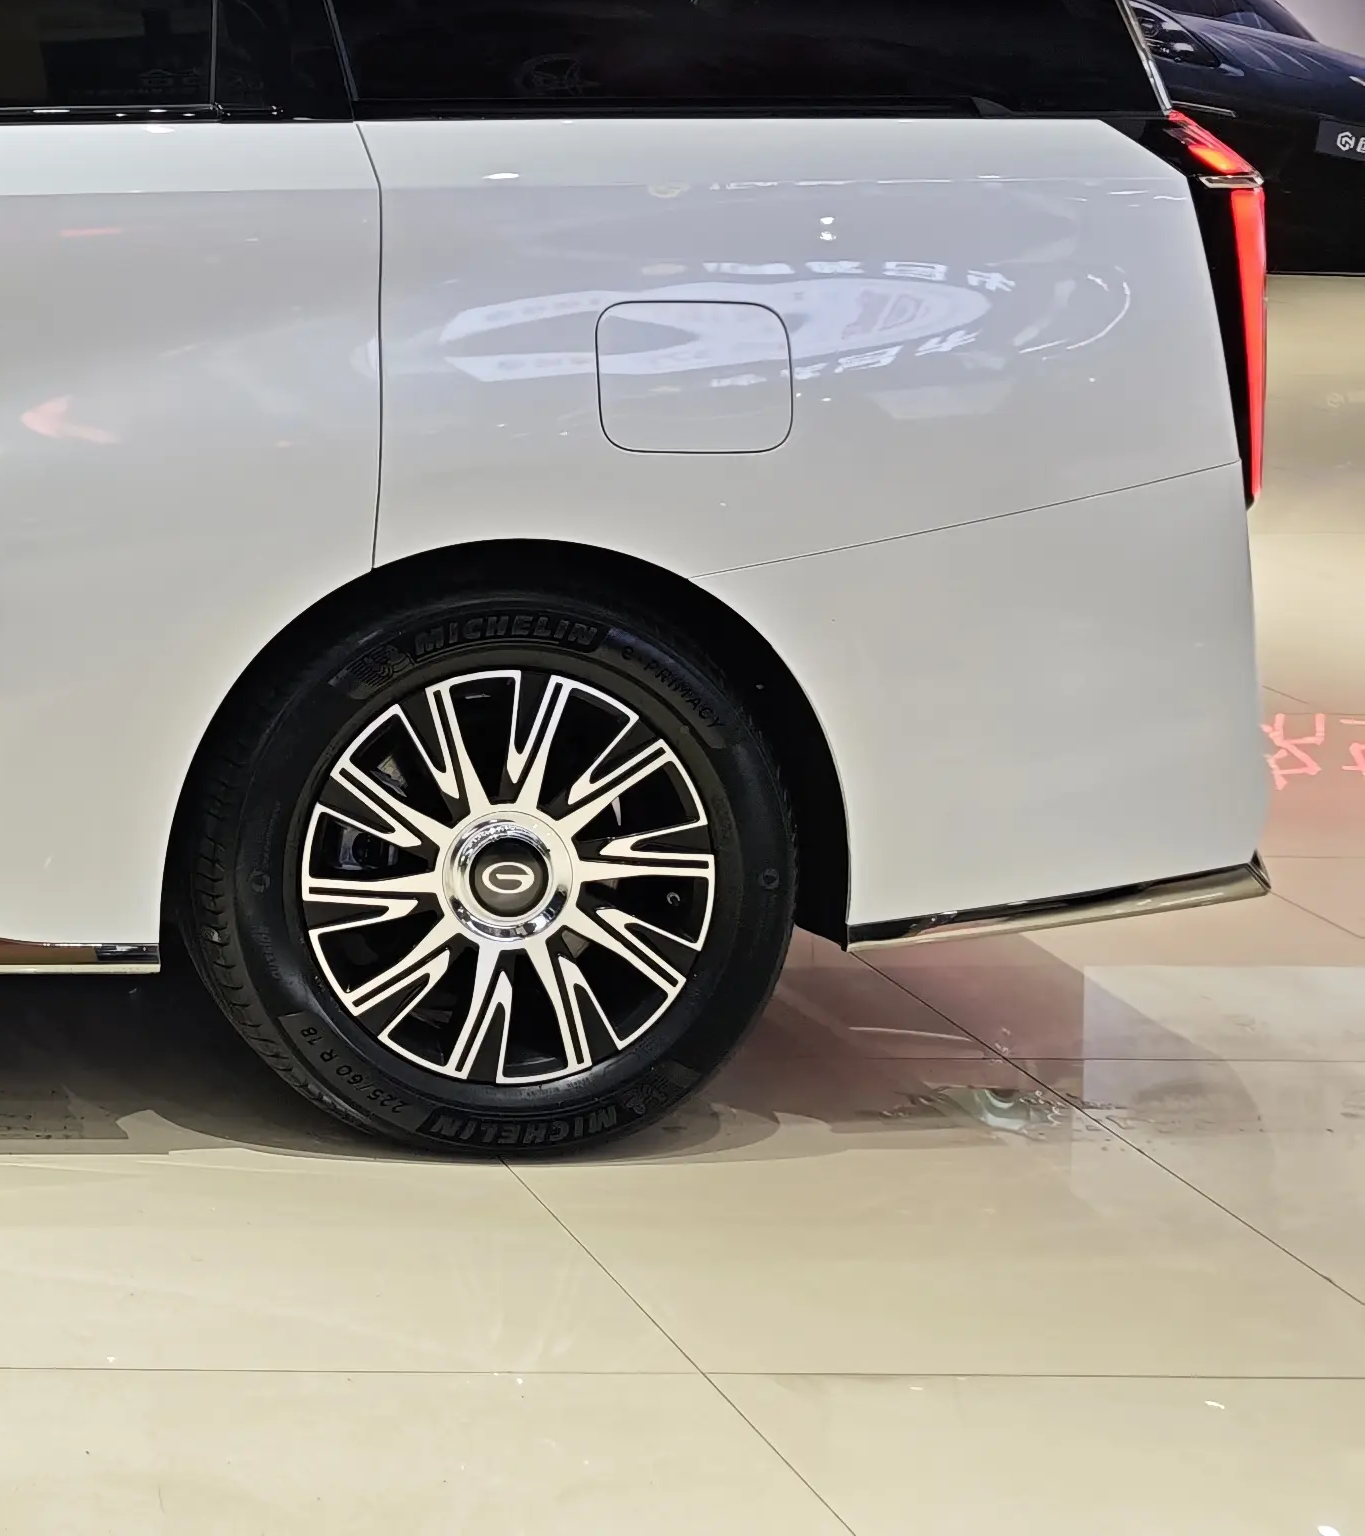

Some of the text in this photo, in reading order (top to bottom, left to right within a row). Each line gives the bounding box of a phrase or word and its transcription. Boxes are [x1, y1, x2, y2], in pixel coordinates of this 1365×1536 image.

[414, 614, 598, 657] MICHELIN
[300, 1025, 415, 1115] 225/60 R 18
[429, 1102, 618, 1145] MICHELIN
